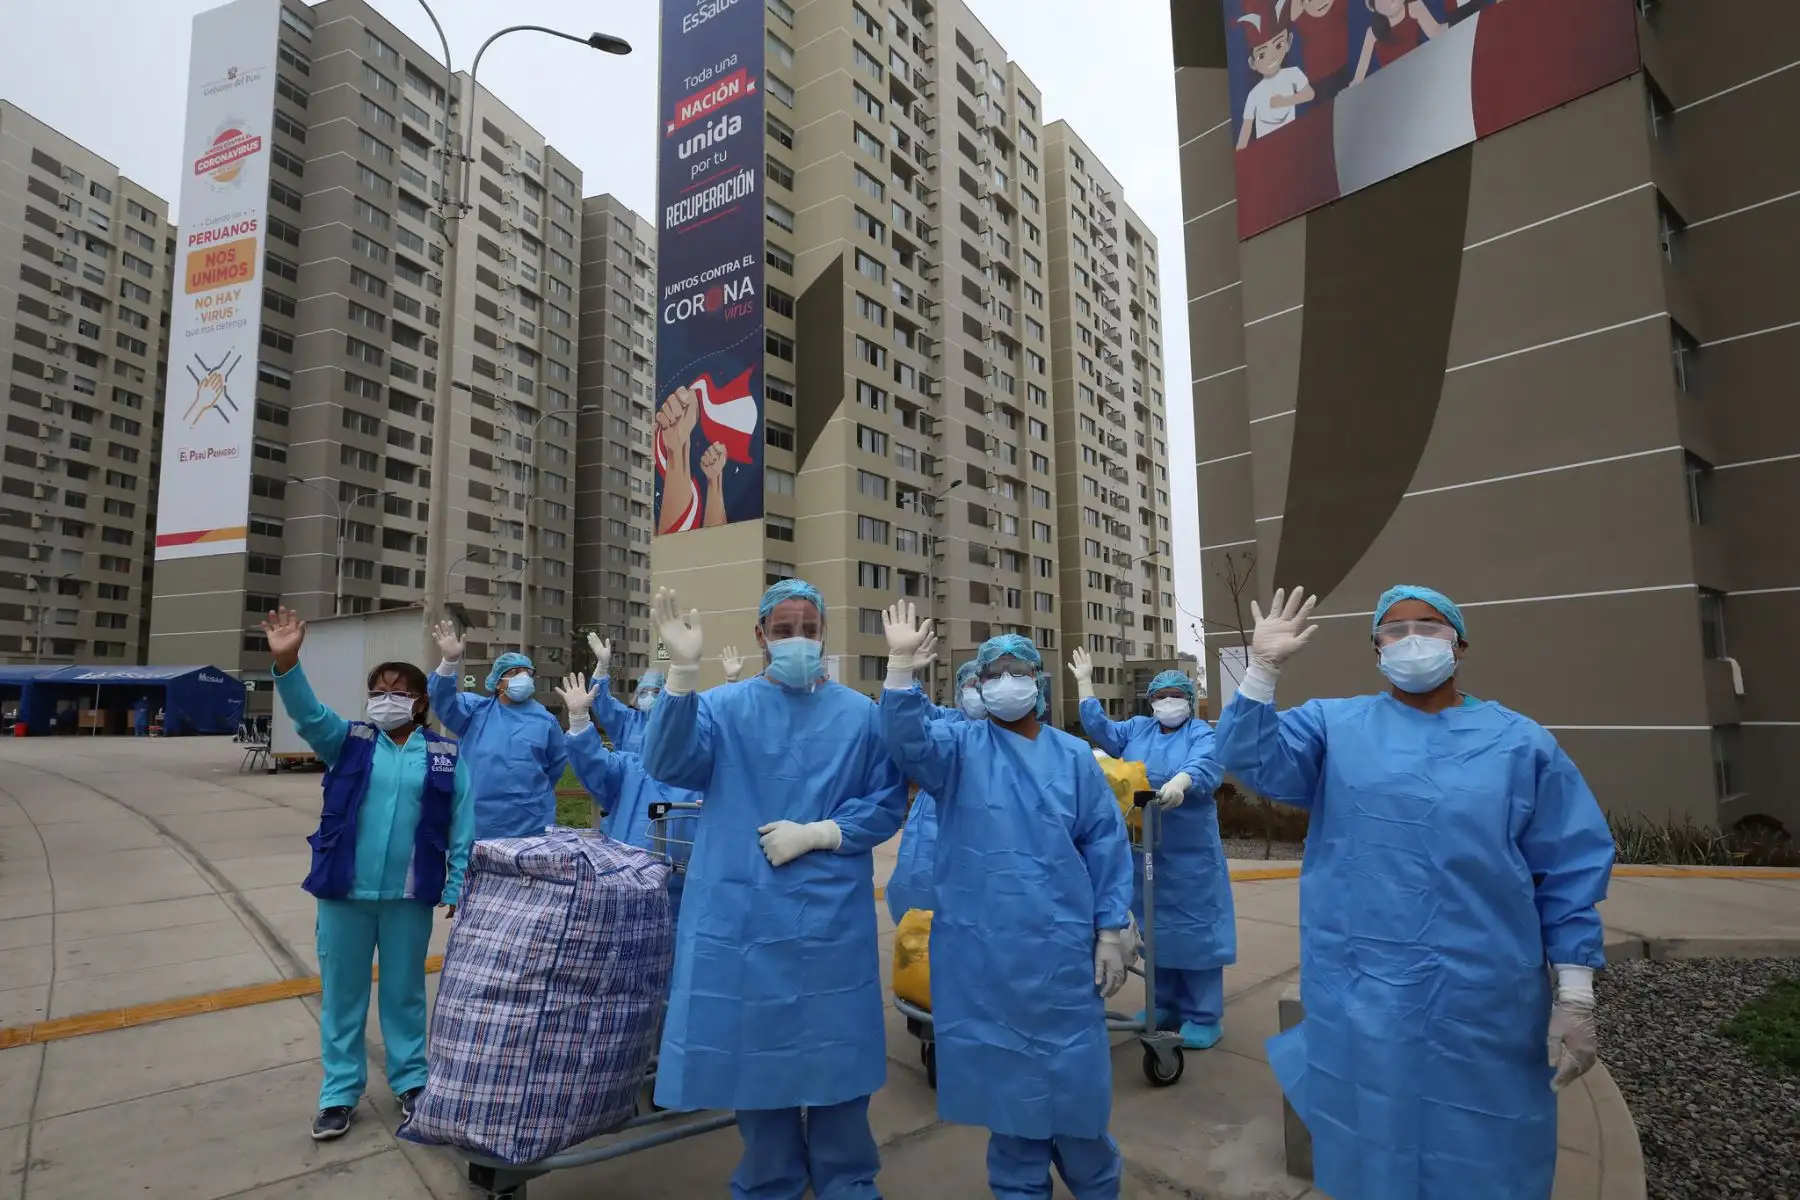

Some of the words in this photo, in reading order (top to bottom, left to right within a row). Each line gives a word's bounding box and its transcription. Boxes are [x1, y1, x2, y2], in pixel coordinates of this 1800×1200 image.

[684, 68, 713, 90] Toda
[715, 54, 738, 74] una
[681, 78, 740, 121] NACIÓN
[678, 115, 742, 159] unida
[197, 140, 259, 171] CORONAVIRUS
[691, 157, 711, 181] por
[713, 150, 727, 165] tu
[666, 168, 755, 229] RECUPERACIÓN
[188, 219, 258, 247] PERUANOS
[205, 248, 237, 268] NOS
[191, 261, 248, 287] UNIMOS
[664, 275, 699, 300] JUNTOS
[700, 259, 741, 283] CONTRA
[742, 254, 755, 268] EL
[195, 295, 213, 310] NO
[215, 289, 242, 306] HAY
[200, 307, 234, 323] VIRUS
